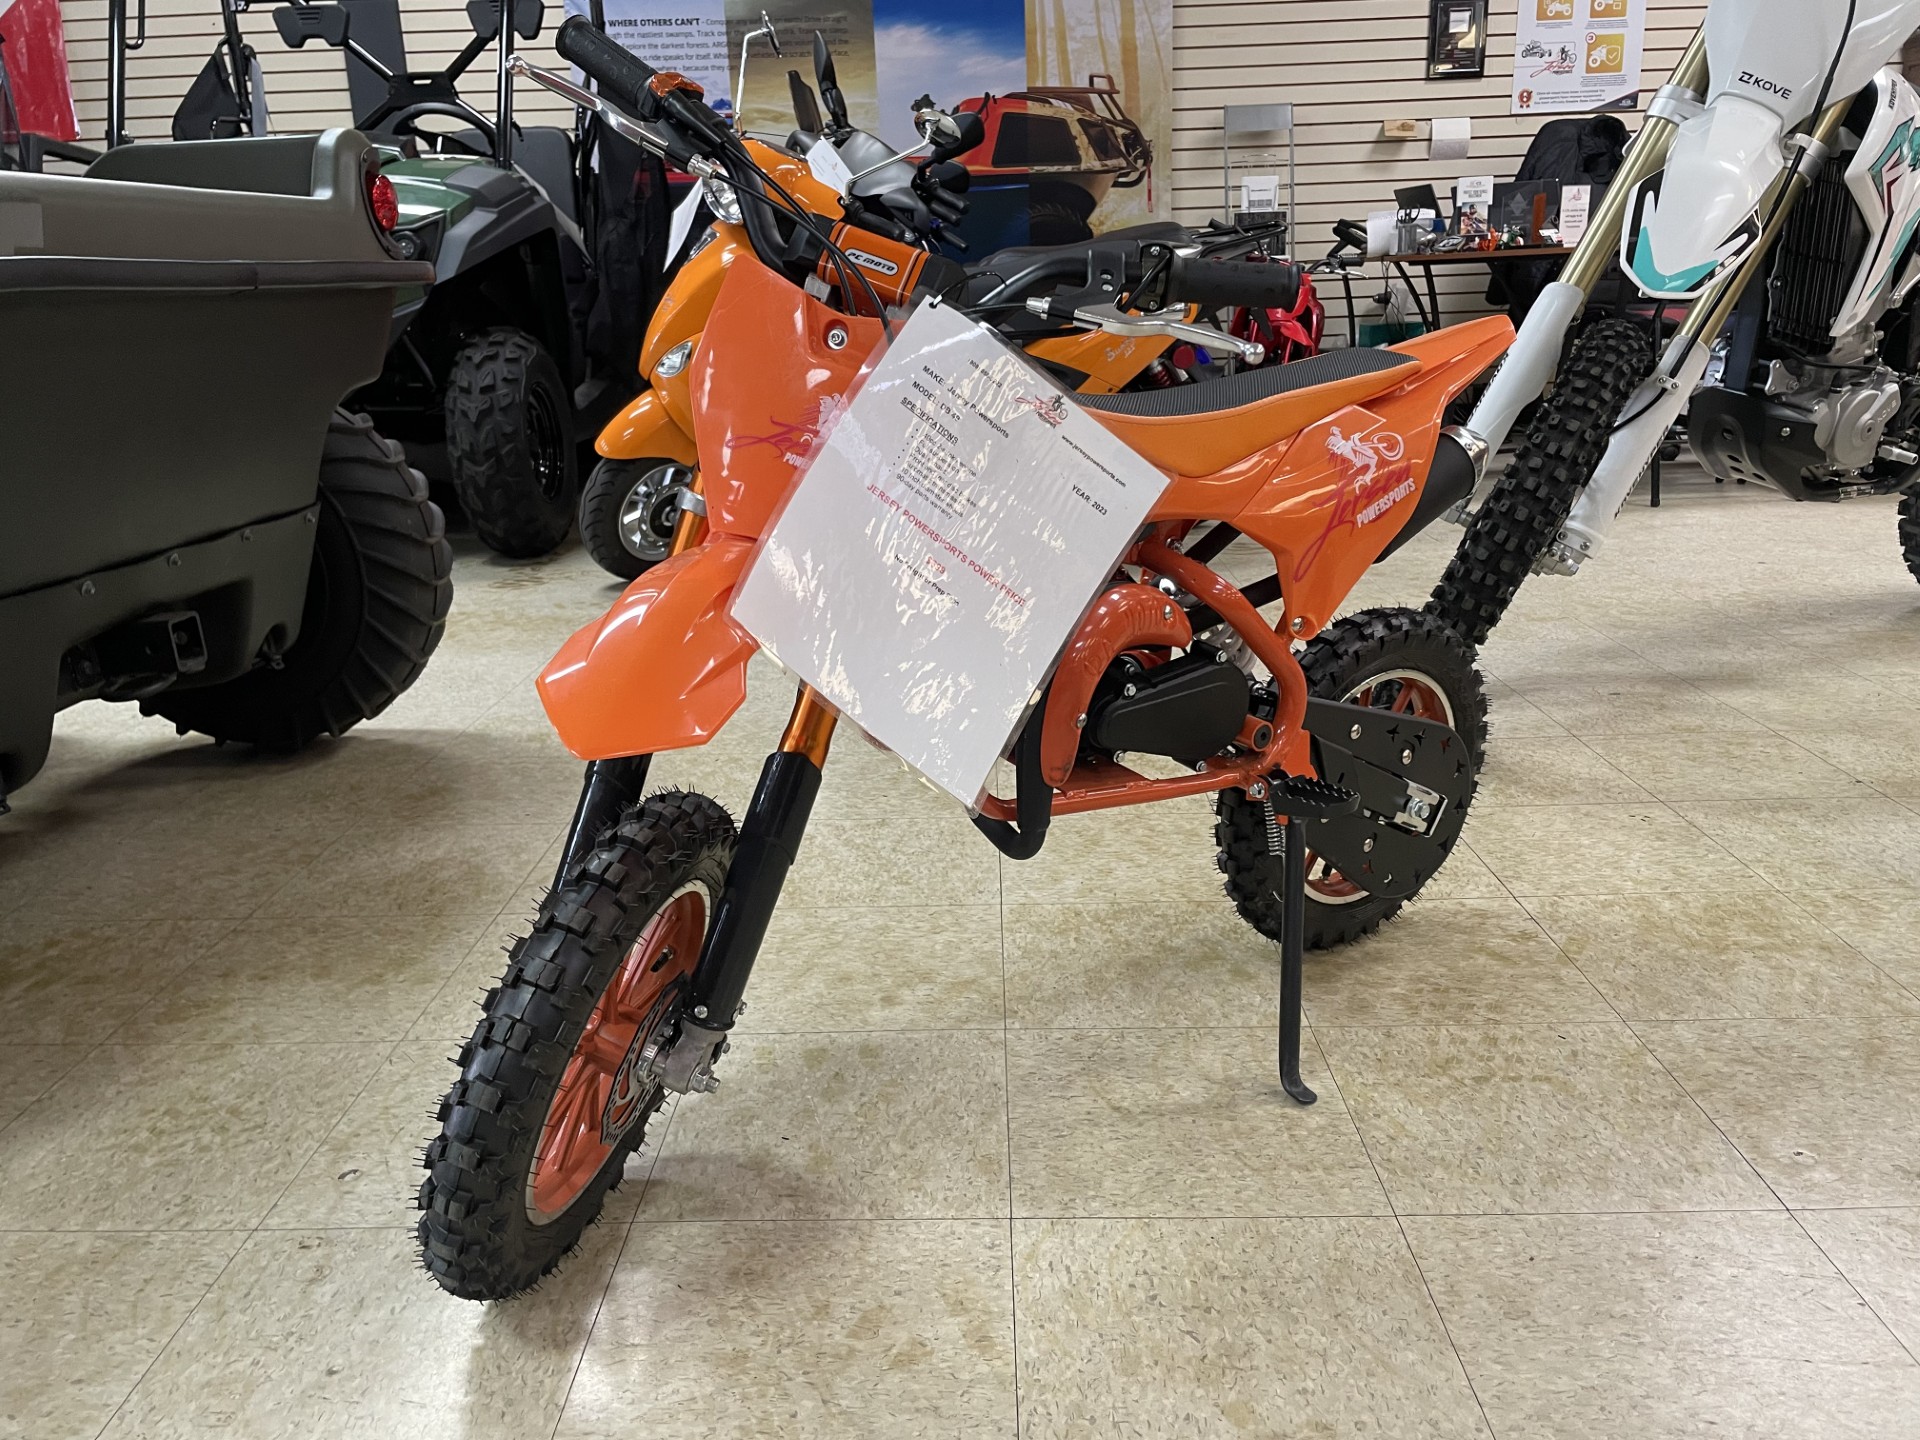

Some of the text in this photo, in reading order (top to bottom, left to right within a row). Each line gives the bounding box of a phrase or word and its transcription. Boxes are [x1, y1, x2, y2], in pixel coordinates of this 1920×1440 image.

[608, 19, 639, 27] WHERE
[640, 18, 673, 26] OTHERS
[675, 18, 700, 26] CAN'T
[624, 30, 636, 38] the
[697, 30, 716, 38] Track
[648, 42, 658, 50] the
[1752, 76, 1792, 100] KOVE
[863, 258, 895, 272] MOTO
[912, 380, 940, 406] MODEL:
[902, 396, 959, 445] SPECIFICATIONS
[896, 473, 954, 520] 90-day parts warranty
[1072, 484, 1108, 516] YEAR: 2023
[1356, 477, 1416, 528] POWERSPORTS
[867, 484, 1028, 608] JERSEY POWERSPORTS POWER PRICE
[894, 554, 904, 564] No
[932, 582, 946, 597] Prep
